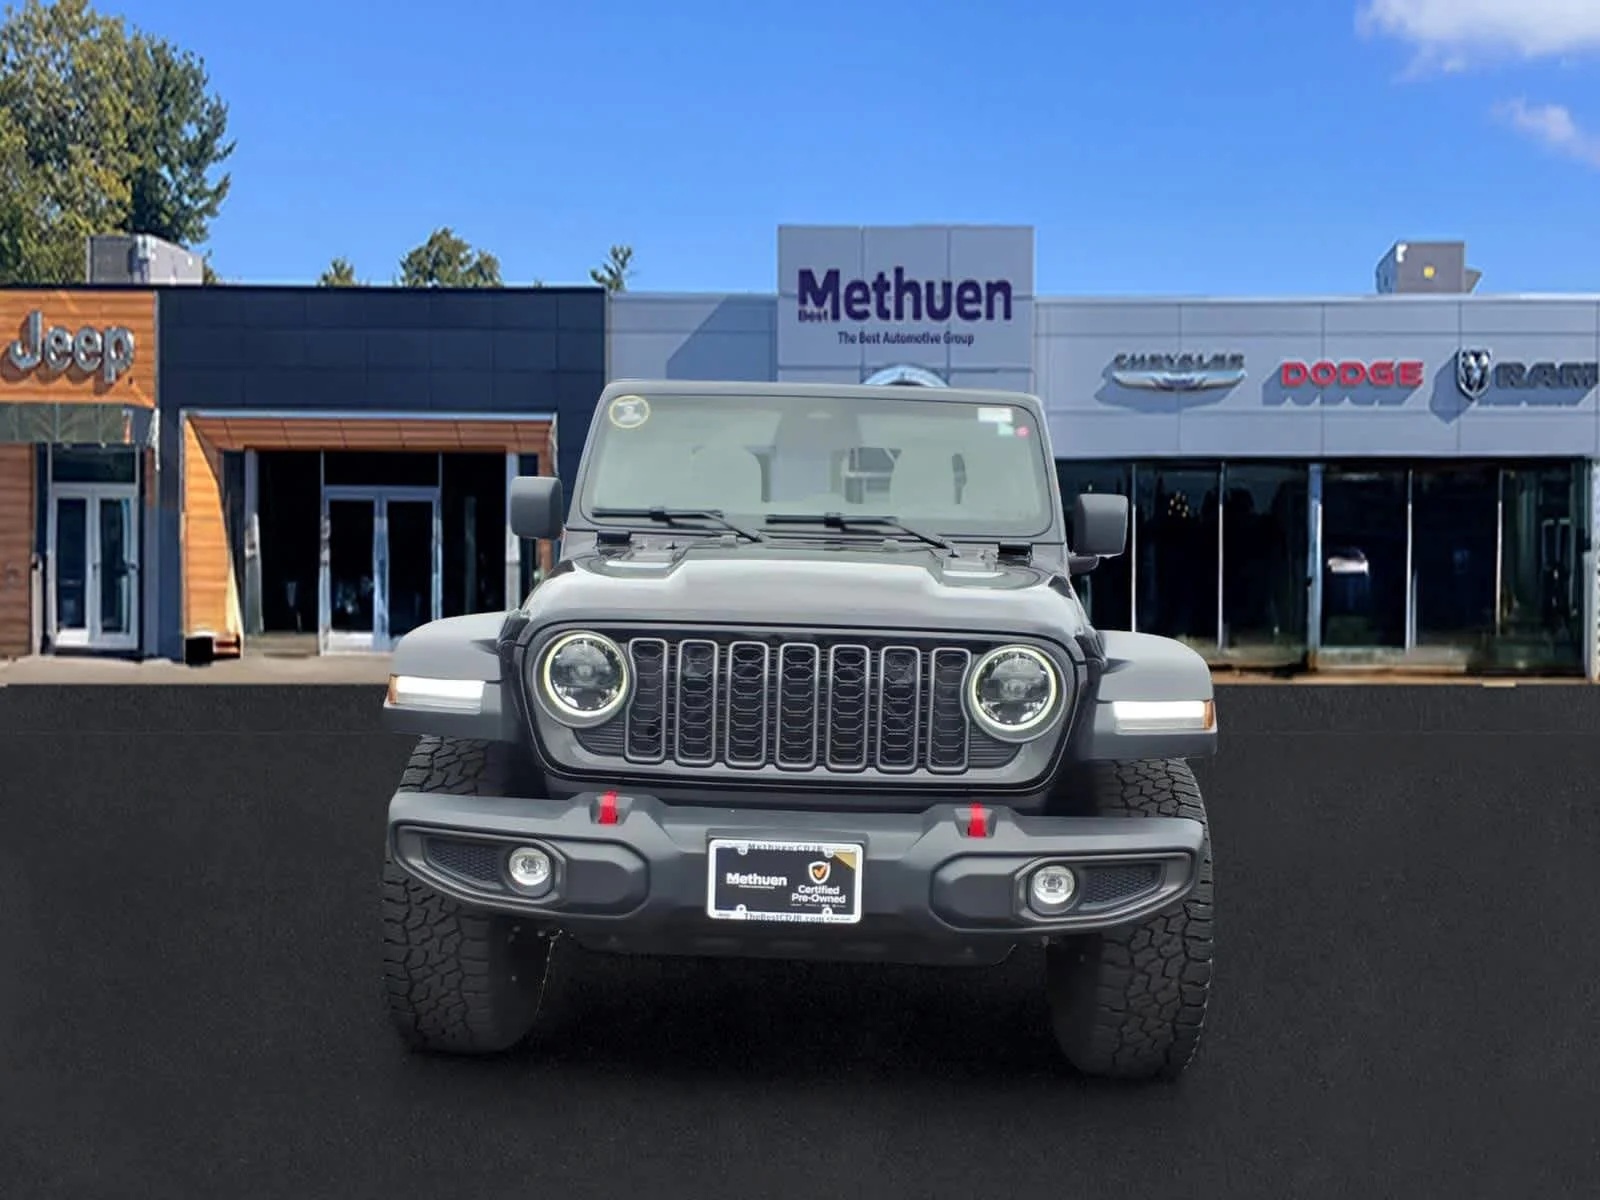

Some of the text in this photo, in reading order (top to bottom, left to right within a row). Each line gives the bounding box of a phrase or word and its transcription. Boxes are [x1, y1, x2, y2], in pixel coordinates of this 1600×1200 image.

[798, 267, 1012, 322] Methuen
[9, 310, 135, 384] Jeep
[838, 331, 975, 346] The Best Automotive Group
[1114, 353, 1245, 370] CHRYSLER
[1281, 361, 1424, 387] DODGE
[1496, 362, 1599, 389] RAM
[726, 873, 788, 886] Methuen
[791, 893, 846, 903] Pre-Owned
[798, 885, 840, 894] Certified
